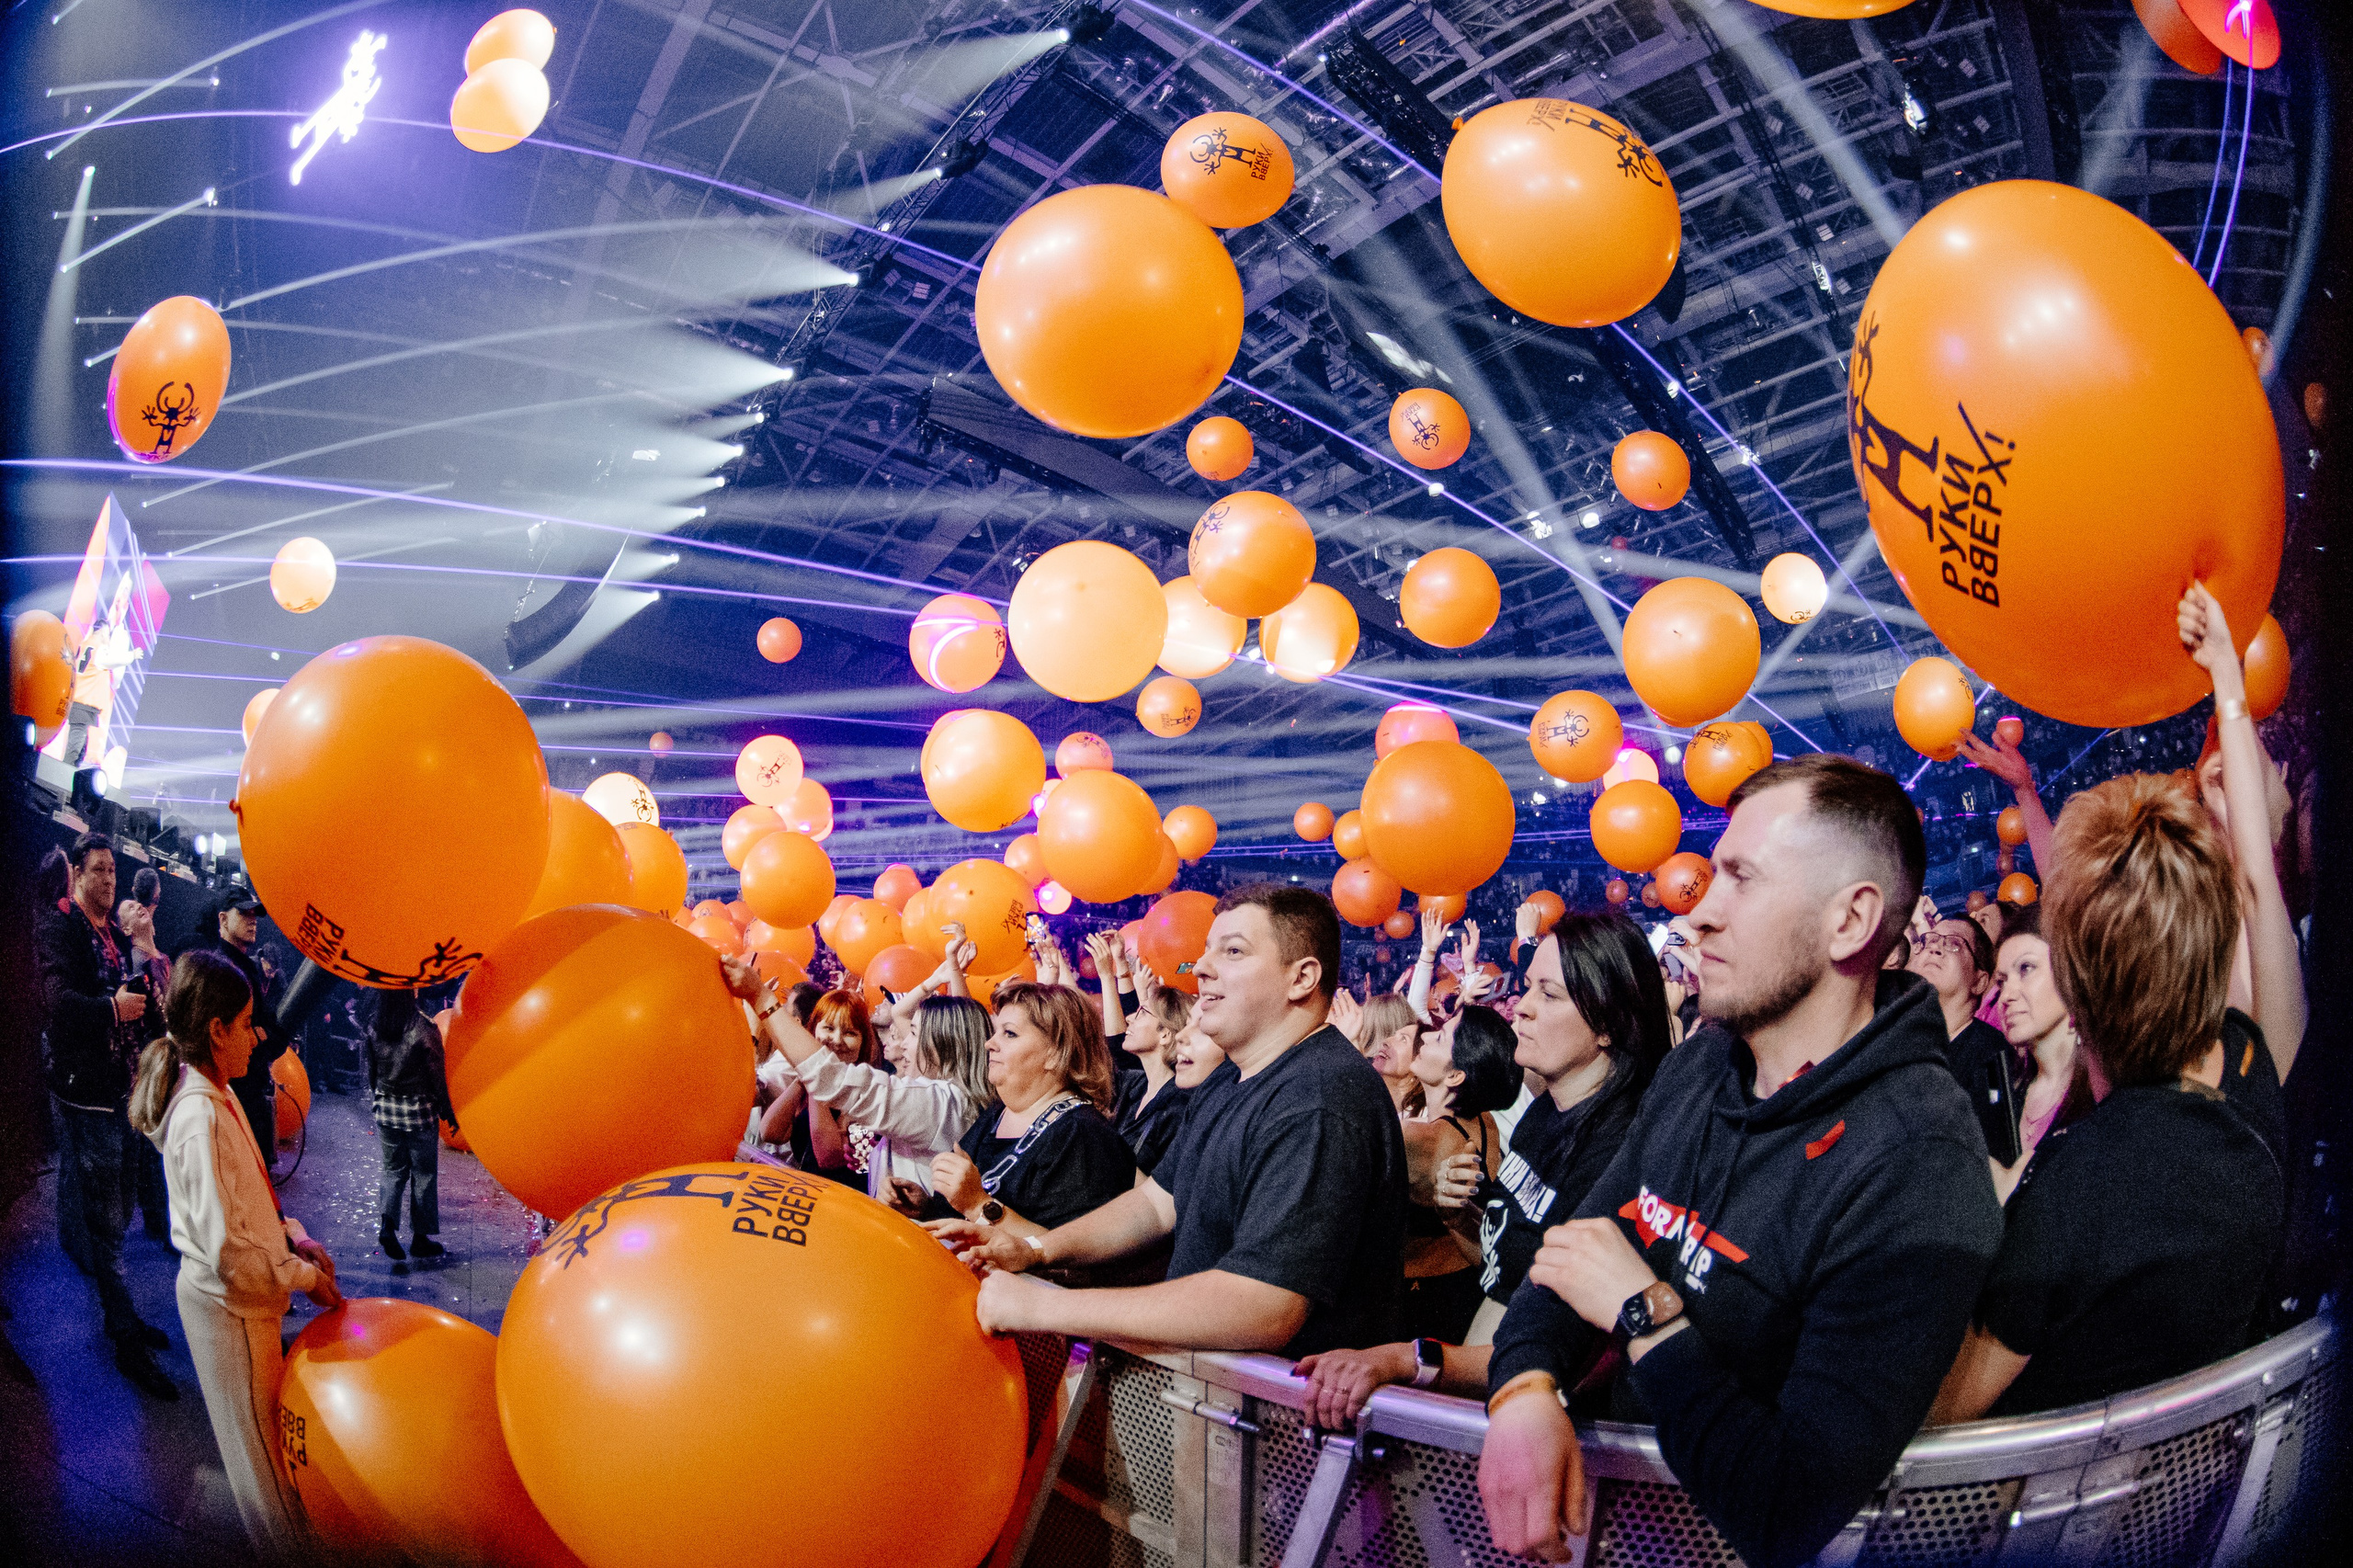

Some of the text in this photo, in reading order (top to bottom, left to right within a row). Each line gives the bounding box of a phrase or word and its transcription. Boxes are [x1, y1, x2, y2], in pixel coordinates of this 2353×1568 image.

[1251, 151, 1265, 178] РУКИ
[1257, 142, 1274, 181] ВВЕРХ!
[1938, 452, 1975, 596] РУКИ
[1957, 401, 2017, 608] ВВЕРХ!
[293, 903, 324, 960] ВВЕР
[312, 917, 345, 964] РУКИ
[732, 1175, 790, 1237] РУКИ
[771, 1166, 831, 1247] ВВЕРХ!
